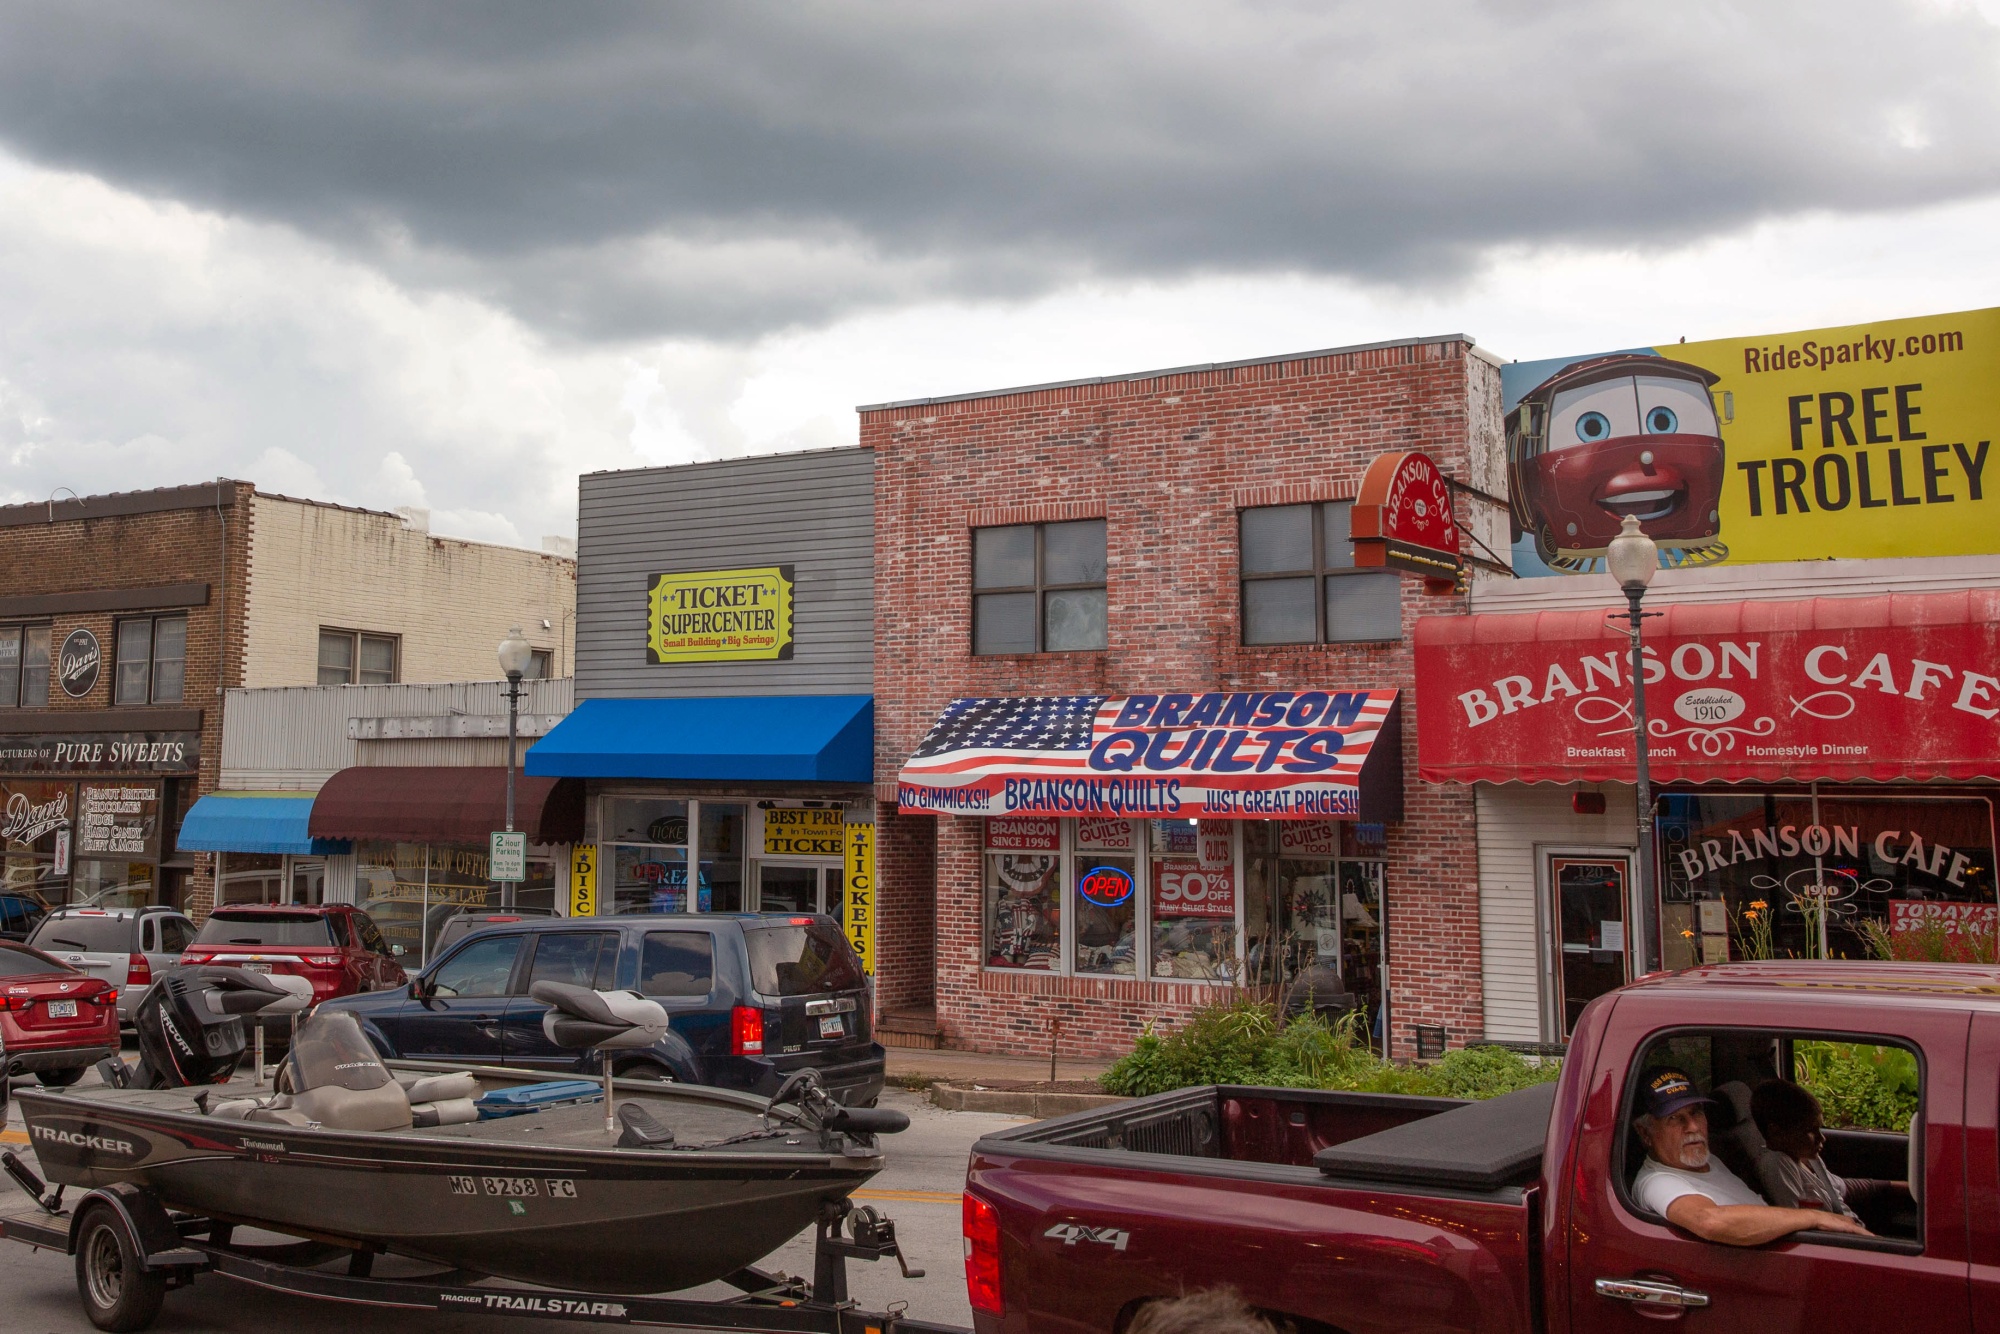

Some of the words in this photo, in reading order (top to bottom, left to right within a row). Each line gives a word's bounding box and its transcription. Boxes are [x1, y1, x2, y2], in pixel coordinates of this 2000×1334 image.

[1744, 330, 1964, 374] RideSparky.com
[1788, 383, 1927, 451] FREE
[1738, 441, 1991, 517] TROLLEY
[1389, 460, 1431, 531] BRANSON
[1432, 479, 1453, 545] CAFE
[675, 583, 764, 610] TICKET
[662, 608, 775, 635] SUPERCENTER
[663, 638, 685, 648] Small
[687, 636, 721, 648] Building
[727, 636, 741, 647] Big
[743, 634, 775, 647] Savings
[60, 646, 98, 679] Davis
[1458, 641, 1761, 728] BRANSON
[1803, 643, 2000, 720] CAFE
[1685, 694, 1733, 707] Established
[1112, 691, 1371, 729] BRANSON
[1693, 703, 1727, 720] 1910
[40, 748, 51, 759] OF
[54, 742, 103, 763] PURE
[109, 741, 185, 763] SWEETS
[1088, 729, 1345, 773] QUILTS
[1567, 746, 1626, 758] Breakfast
[1647, 746, 1677, 758] unch
[1746, 744, 1818, 757] Homestyle
[1822, 743, 1869, 756] Dinner
[87, 786, 120, 800] PEANUT
[121, 786, 155, 800] BRITTLE
[897, 787, 916, 809] NO
[918, 787, 990, 810] GIMMICKS!!
[1004, 777, 1103, 813] BRANSON
[1109, 778, 1181, 817] QUILTS
[1202, 789, 1240, 813] JUST
[1243, 790, 1290, 813] GREAT
[1297, 789, 1359, 815] PRICES!!
[85, 799, 141, 813] CHOCOLATES
[1, 791, 68, 838] Davis
[84, 812, 114, 826] FUDGE
[769, 810, 808, 825] BEST
[84, 825, 109, 838] HARD
[111, 825, 143, 839] CANDY
[802, 828, 828, 836] Town
[830, 828, 843, 836] Fo
[990, 822, 1056, 836] BRANSON
[1080, 821, 1132, 843] QUILTS
[1281, 825, 1333, 848] QUILTS
[84, 838, 109, 851] TAFFY
[109, 839, 117, 852] &
[118, 839, 144, 852] MORE
[496, 835, 504, 847] 2
[769, 838, 844, 853] TICKE
[991, 836, 1022, 847] SINCE
[1025, 837, 1051, 848] 1996
[1101, 836, 1130, 848] TOO!
[1356, 831, 1387, 844] QUIL
[496, 848, 521, 858] Parking
[1205, 840, 1229, 862] QUILTS
[1303, 842, 1332, 853] TOO!
[456, 850, 490, 880] OFFIC
[1679, 825, 1859, 882] BRANSON
[1875, 830, 1971, 889] CAFE
[1163, 862, 1197, 871] BRANSON
[1577, 866, 1604, 879] 120
[575, 862, 592, 917] DISC
[1083, 876, 1130, 898] OPEN
[1160, 872, 1230, 902] 50%
[1803, 884, 1840, 896] 1910
[460, 888, 488, 904] LAW
[850, 843, 870, 954] TICKETS
[1208, 890, 1232, 901] OFF
[1159, 901, 1180, 912] MANY
[1182, 902, 1206, 912] SELECT
[1207, 903, 1233, 913] STYLES
[783, 1044, 802, 1053] PILOT
[31, 1125, 134, 1155] TRACKER
[240, 1137, 286, 1151] Tournament
[450, 1176, 475, 1194] MO
[547, 1179, 575, 1197] FC
[440, 1293, 482, 1304] TRACKER
[484, 1294, 608, 1316] TRAILSTAR
